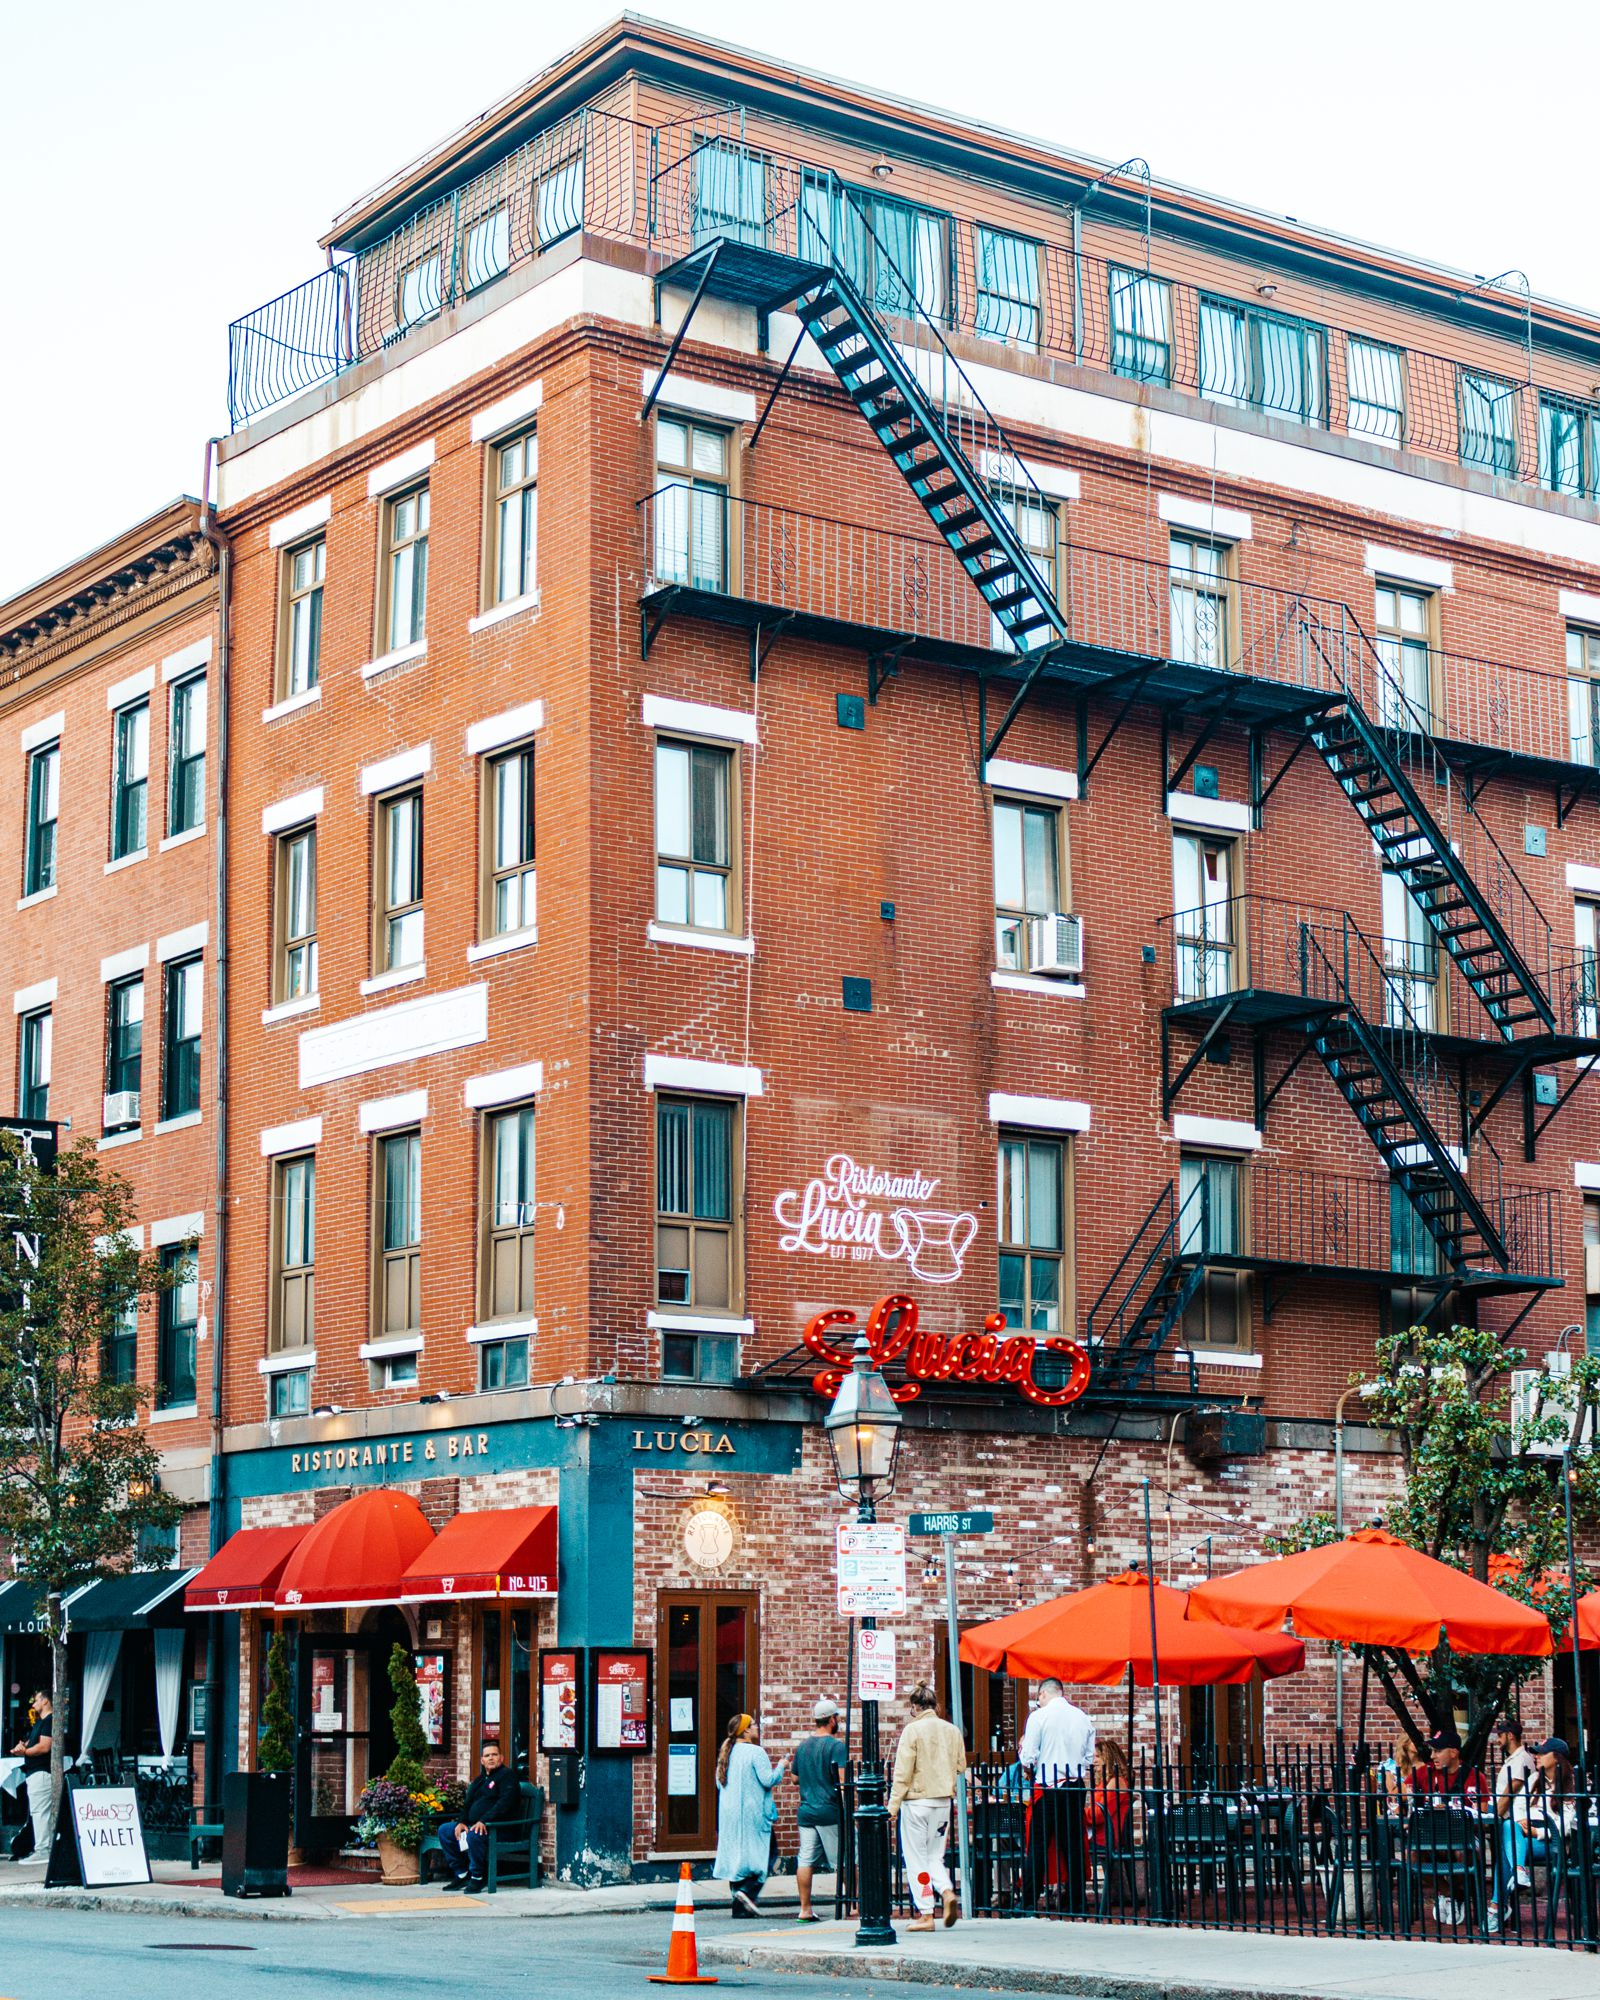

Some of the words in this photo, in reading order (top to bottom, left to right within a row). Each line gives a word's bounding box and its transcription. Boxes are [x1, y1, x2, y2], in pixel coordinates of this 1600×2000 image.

[826, 1154, 940, 1210] Ristorante
[775, 1180, 906, 1258] Lucia
[851, 1247, 873, 1260] 1977
[802, 1294, 1091, 1406] Lucia
[632, 1430, 736, 1453] LUCIA
[292, 1441, 412, 1473] RISTORANTE
[424, 1438, 436, 1460] &
[448, 1433, 489, 1457] BAR
[924, 1514, 959, 1531] HARRIS
[962, 1518, 972, 1530] ST
[845, 1561, 856, 1569] 2
[528, 1576, 548, 1591] 415
[79, 1803, 116, 1821] Lucia
[88, 1828, 134, 1847] VALET
